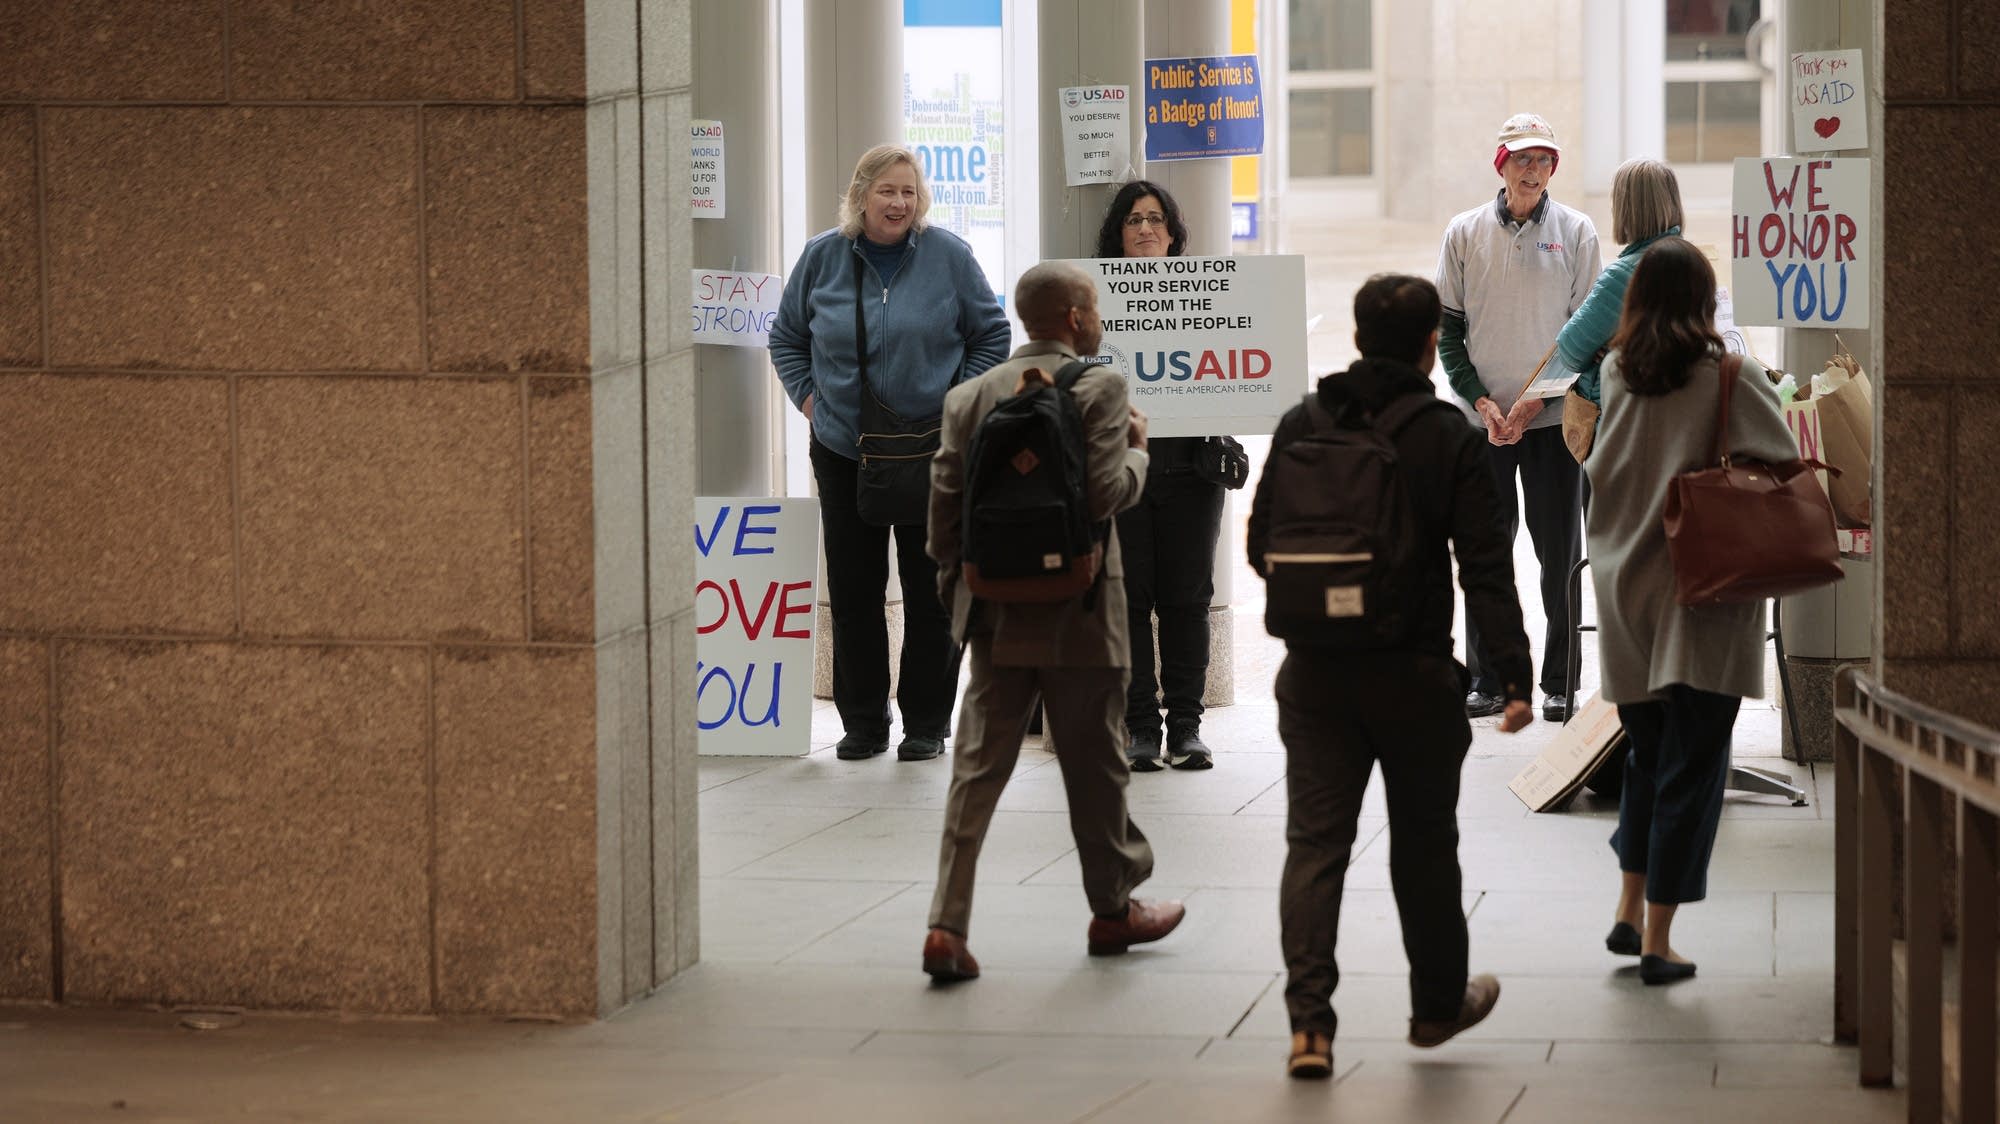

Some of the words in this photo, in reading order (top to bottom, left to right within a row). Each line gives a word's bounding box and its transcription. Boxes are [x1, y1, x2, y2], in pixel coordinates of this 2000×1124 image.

[1792, 55, 1824, 78] Thank
[1152, 65, 1194, 89] Public
[1199, 62, 1241, 87] Service
[1243, 62, 1253, 84] is
[1083, 89, 1125, 100] USAID
[1797, 80, 1855, 106] USAID
[1148, 106, 1157, 123] a
[1161, 99, 1205, 127] Badge
[1210, 97, 1222, 120] of
[1225, 95, 1259, 120] Honor!
[691, 127, 722, 136] USAID
[692, 148, 720, 157] WORLD
[1083, 151, 1110, 159] BETTER
[691, 161, 716, 170] ANKS
[701, 174, 717, 183] FOR
[1080, 170, 1097, 178] THAN
[691, 186, 710, 195] OUR
[1763, 161, 1832, 212] WE
[931, 185, 986, 205] Welkom
[692, 199, 716, 208] RVICE.
[1733, 213, 1857, 263] HONOR
[1100, 262, 1158, 275] THANK
[1164, 261, 1197, 273] YOU
[1203, 260, 1236, 272] FOR
[699, 275, 768, 302] STAY
[1108, 281, 1153, 293] YOUR
[1158, 279, 1229, 292] SERVICE
[1765, 259, 1848, 322] YOU
[1127, 300, 1174, 312] FROM
[1179, 298, 1212, 311] THE
[1101, 318, 1176, 331] MERICAN
[1182, 316, 1252, 330] PEOPLE!
[1135, 349, 1272, 382] USAID
[1135, 387, 1162, 396] FROM
[1165, 386, 1184, 395] THE
[1186, 385, 1236, 394] AMERICAN
[1238, 384, 1272, 393] PEOPLE
[696, 579, 811, 640] OVE
[697, 661, 781, 729] OU
